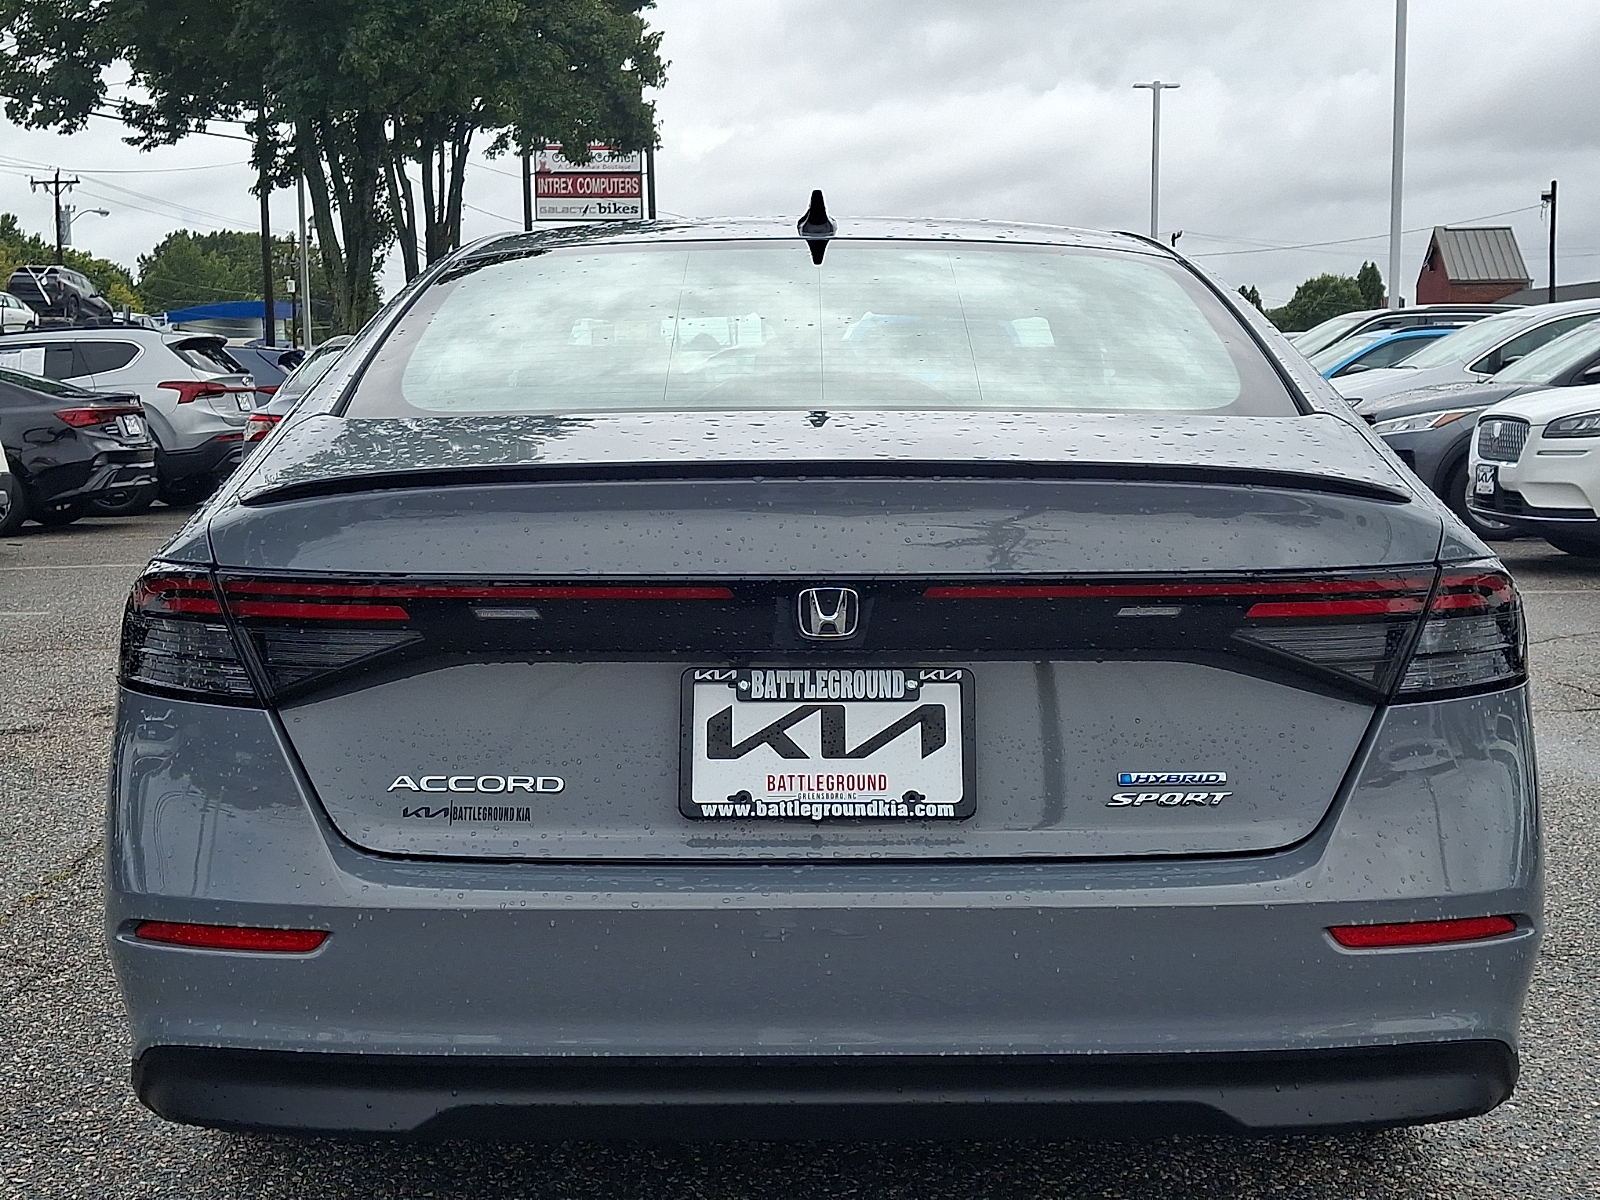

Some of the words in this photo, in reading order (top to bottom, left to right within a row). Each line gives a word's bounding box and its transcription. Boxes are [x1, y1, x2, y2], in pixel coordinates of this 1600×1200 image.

[537, 177, 573, 194] INTREX
[576, 177, 639, 194] COMPUTERS
[597, 202, 639, 215] bikes
[751, 669, 906, 700] BATTLEGROUND
[387, 775, 566, 793] ACCORD
[766, 774, 888, 792] BATTLEGROUND
[1134, 773, 1221, 784] HYBRID
[1106, 791, 1233, 807] SPORT
[452, 806, 515, 822] BATTLEGROUND
[515, 807, 531, 822] KIA
[701, 800, 955, 821] www.battlegroundkia.com
